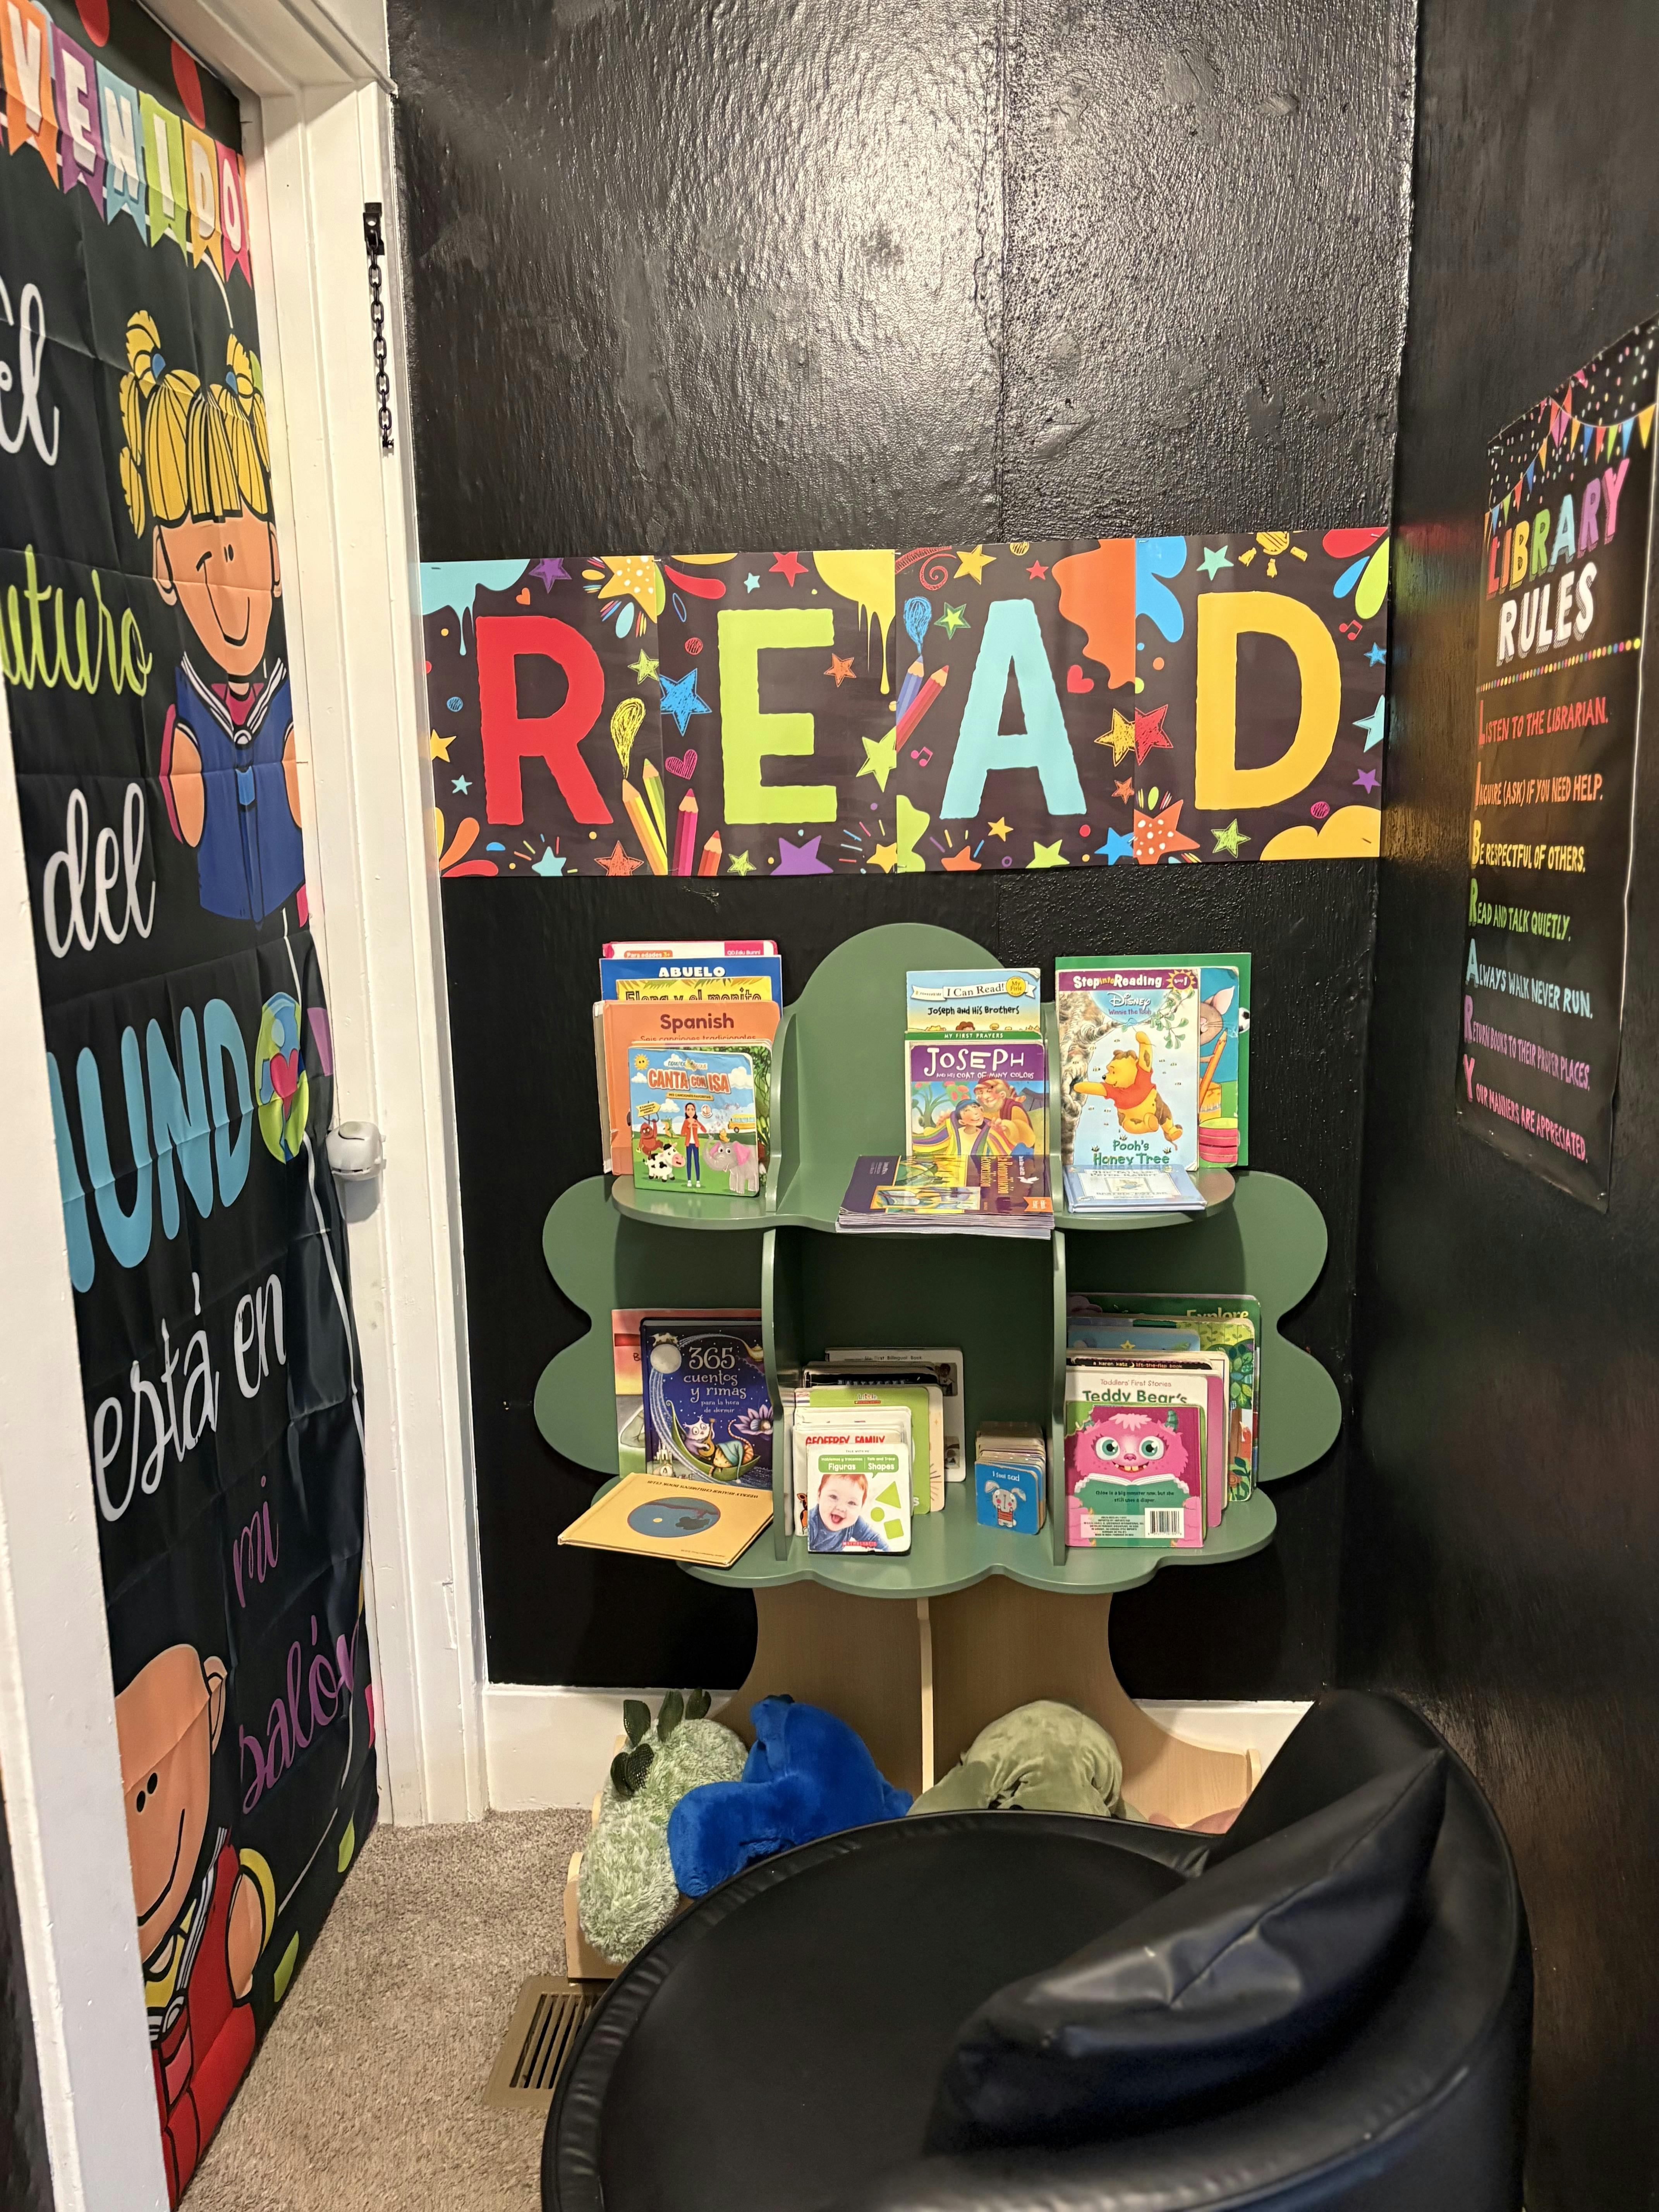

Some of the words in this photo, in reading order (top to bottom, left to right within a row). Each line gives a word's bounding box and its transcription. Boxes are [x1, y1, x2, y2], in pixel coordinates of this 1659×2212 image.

[1487, 458, 1630, 599] LIBRARY
[1496, 562, 1597, 666] RULES
[476, 590, 1341, 825] READ
[1479, 700, 1510, 746] LISTEN
[1512, 716, 1524, 739] TO
[1527, 710, 1545, 737] THE
[1547, 697, 1608, 733] LIBRARIAN.
[1475, 761, 1502, 807] INQUIRE
[1503, 779, 1525, 806] (ASK)
[1526, 780, 1535, 804] IF
[1535, 779, 1550, 804] YOU
[1551, 776, 1571, 802] NEED
[1573, 774, 1603, 801] HELP.
[1471, 820, 1485, 867] BE
[1486, 843, 1532, 869] RESPECTFUL
[1534, 845, 1546, 869] OF
[1548, 845, 1585, 872] OTHERS.
[44, 783, 155, 958] del
[1469, 878, 1492, 925] READ
[1493, 904, 1507, 929] AND
[1508, 907, 1530, 933] TALK
[1531, 911, 1571, 941] QUIETLY.
[659, 967, 725, 977] ABUELO
[1073, 975, 1100, 989] Step
[1113, 974, 1162, 988] Reading
[1183, 976, 1188, 986] 1
[1466, 938, 1506, 992] ALWAYS
[1509, 972, 1529, 1000] WALK
[1532, 978, 1560, 1010] NEVER
[1563, 988, 1593, 1018] RUN.
[947, 988, 951, 996] I
[953, 988, 971, 997] Can
[976, 984, 1005, 994] Read!
[927, 1006, 955, 1016] Joseph
[972, 1006, 983, 1015] His
[985, 1005, 1020, 1014] Brothers
[660, 1013, 734, 1034] Spanish
[1464, 994, 1490, 1048] RETURN
[1491, 1027, 1507, 1055] BOOKS
[1509, 1036, 1516, 1058] TO
[1518, 1039, 1536, 1068] THEIR
[1537, 1046, 1559, 1079] PROPER
[1561, 1056, 1590, 1091] PLACES.
[924, 1047, 1024, 1077] JOSEPH
[648, 1069, 689, 1089] CANTA
[690, 1075, 706, 1088] CON
[708, 1073, 730, 1093] ISA
[1489, 1089, 1520, 1125] MANNERS
[1521, 1106, 1535, 1133] ARE
[1536, 1113, 1587, 1163] APPRECIATED.
[1113, 1139, 1149, 1151] Pooh's
[1093, 1152, 1134, 1165] Honey
[1136, 1152, 1170, 1164] Tree
[689, 1346, 735, 1369] 365
[684, 1370, 738, 1386] cuentos
[94, 1272, 220, 1521] está
[234, 1274, 286, 1398] en
[690, 1388, 699, 1403] y
[706, 1386, 746, 1399] rimas
[1082, 1388, 1131, 1402] Teddy
[1137, 1390, 1187, 1403] Bear's
[805, 1435, 850, 1446] GEOFFREY
[855, 1435, 885, 1444] FAMILY
[828, 1463, 856, 1472] Figuras
[868, 1463, 895, 1472] Shapes
[233, 1475, 278, 1608] mi
